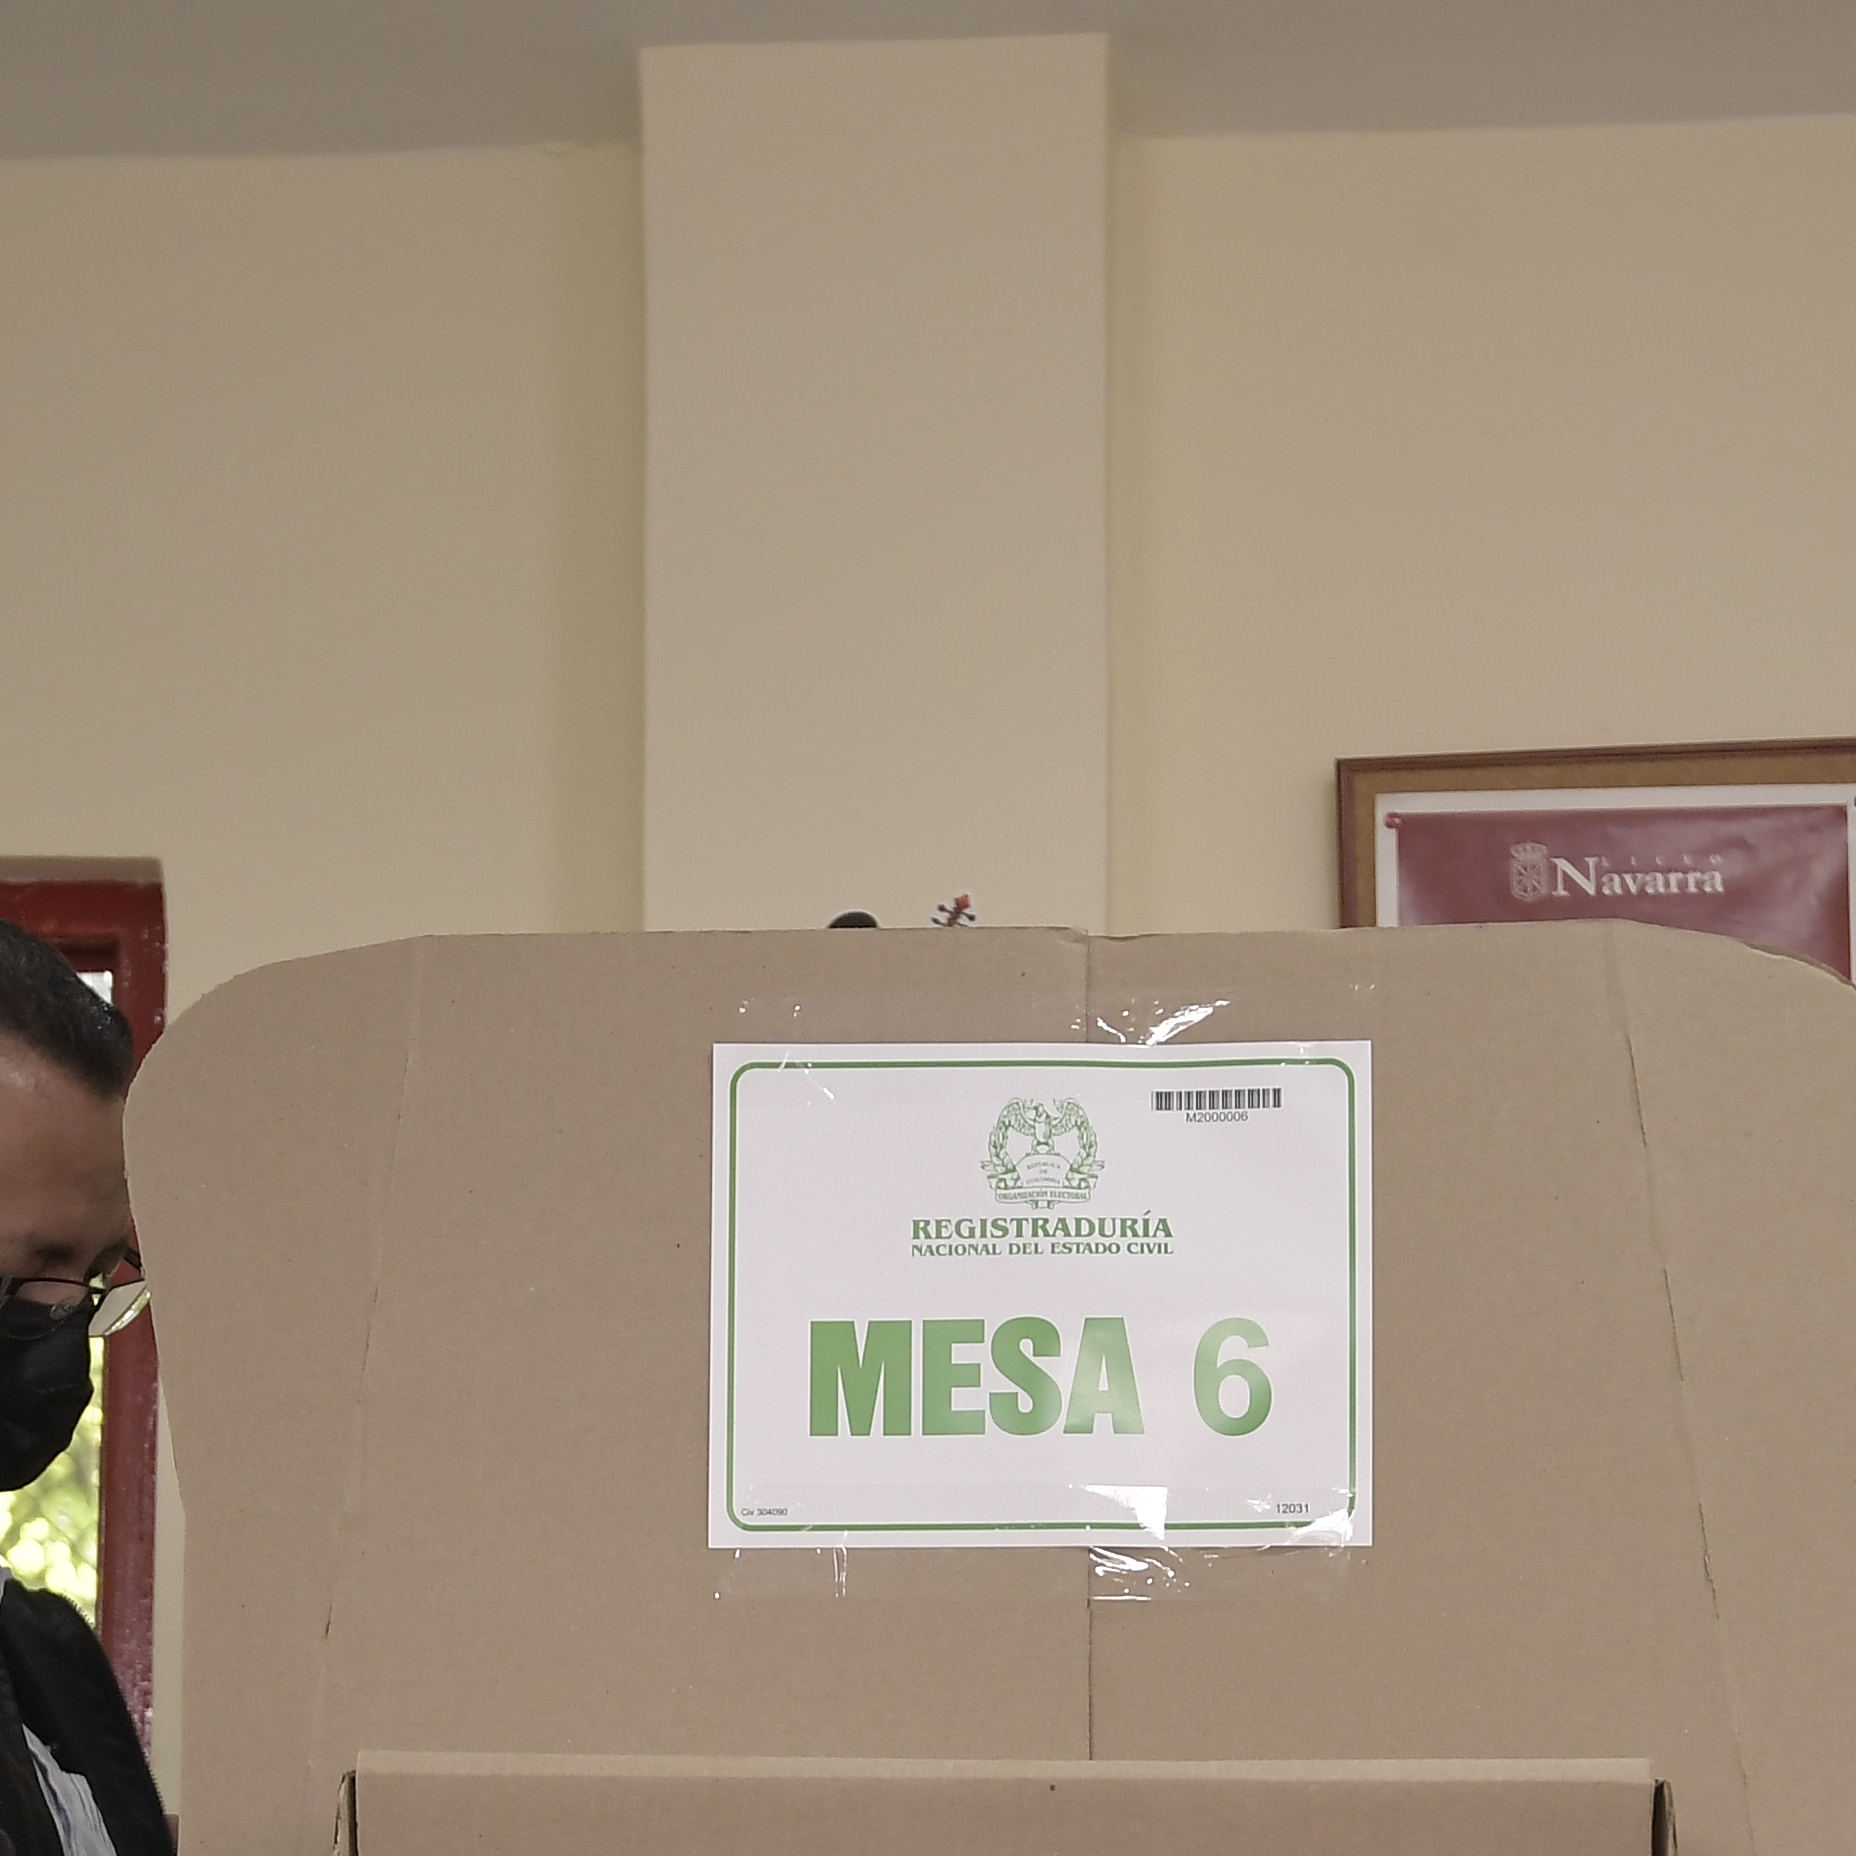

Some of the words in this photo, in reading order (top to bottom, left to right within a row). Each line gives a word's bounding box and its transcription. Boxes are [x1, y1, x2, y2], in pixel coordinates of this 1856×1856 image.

[1549, 856, 1725, 897] Navarra
[1185, 1111, 1249, 1123] M2000006
[911, 1210, 1174, 1240] REGISTRADURÍA
[911, 1243, 1003, 1257] NACIONAL
[1008, 1242, 1044, 1255] DEL
[1050, 1241, 1121, 1255] ESTADO
[1126, 1241, 1174, 1255] CIVIL
[809, 1315, 1146, 1437] MESA
[1192, 1316, 1273, 1437] 6
[1276, 1502, 1309, 1514] 12031
